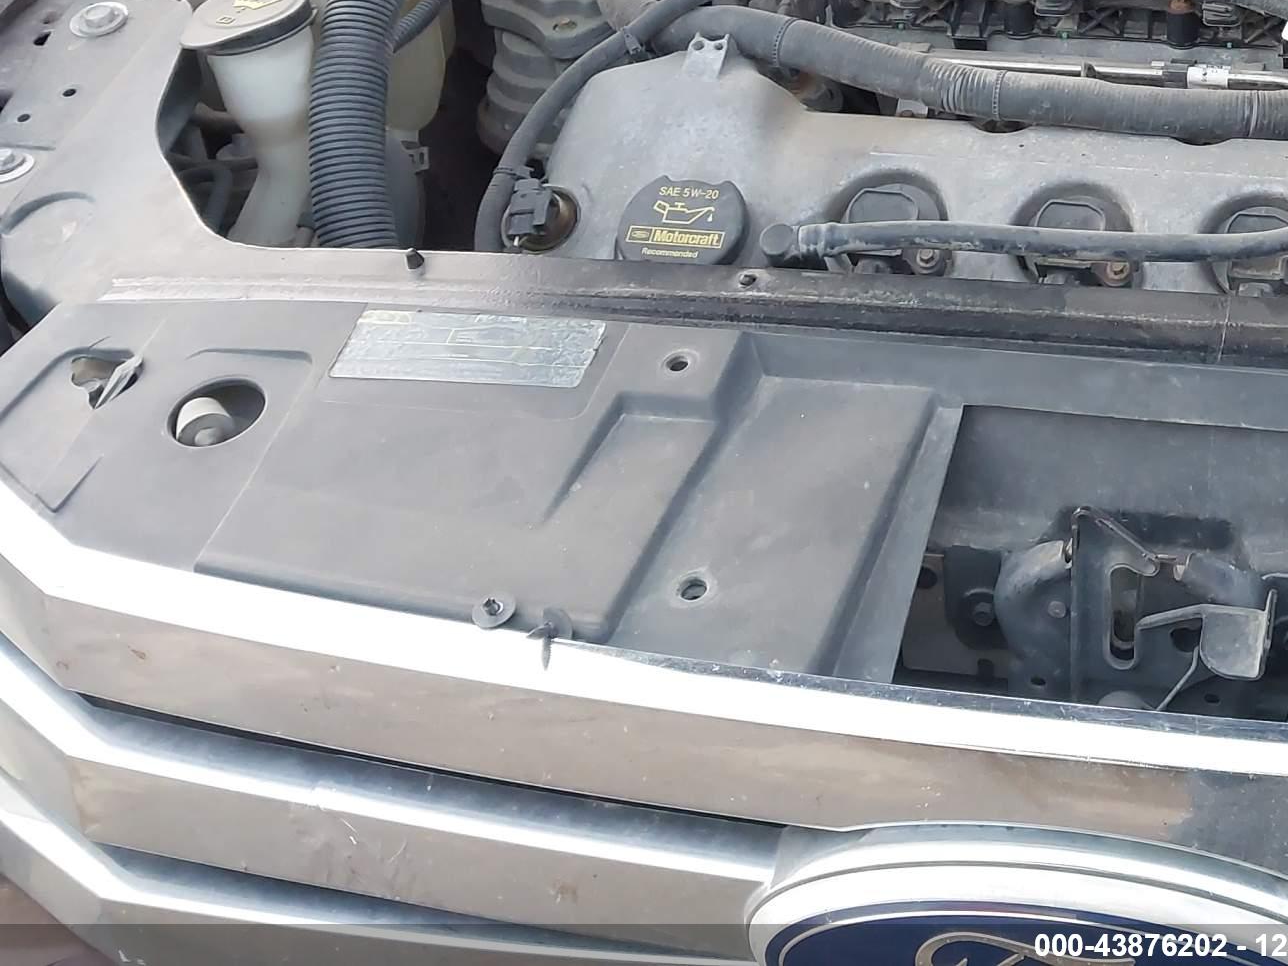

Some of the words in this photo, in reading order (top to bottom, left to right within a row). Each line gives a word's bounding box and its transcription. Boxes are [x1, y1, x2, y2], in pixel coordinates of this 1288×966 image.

[659, 186, 681, 197] SAE
[683, 187, 719, 200] 5W-20
[654, 230, 720, 245] Motorcraft
[642, 248, 698, 258] Recommended
